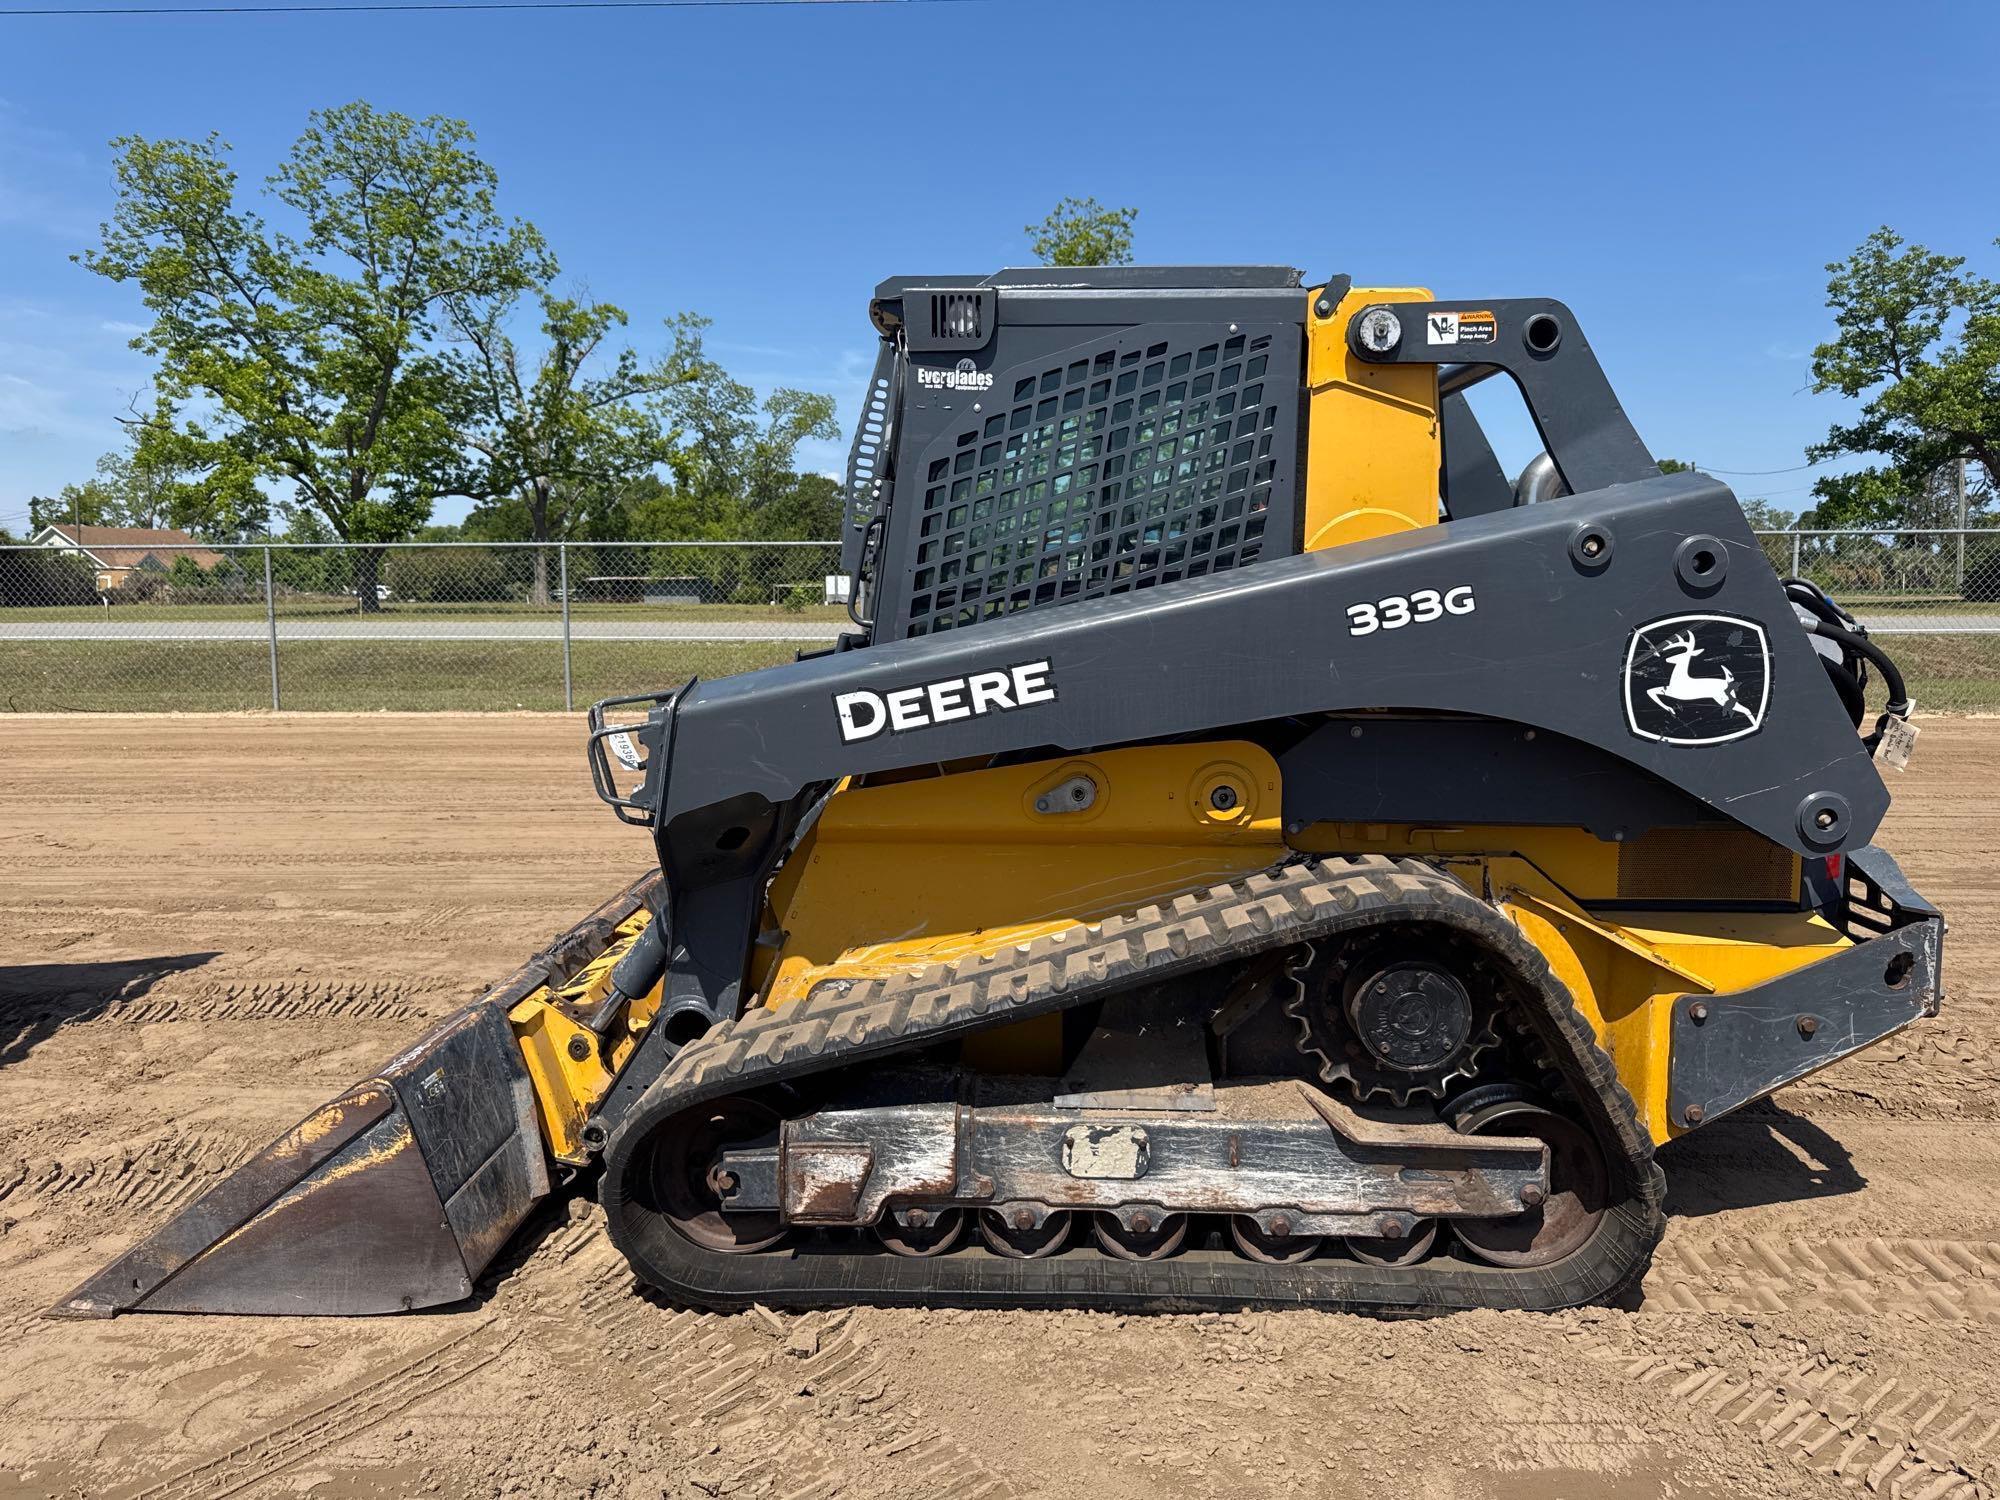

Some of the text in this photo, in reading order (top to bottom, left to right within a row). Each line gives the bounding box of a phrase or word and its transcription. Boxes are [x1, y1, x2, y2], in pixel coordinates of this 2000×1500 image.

[1474, 332, 1488, 340] Away
[917, 368, 994, 388] Everglades
[1346, 585, 1476, 637] 333G
[835, 660, 1056, 742] DEERE
